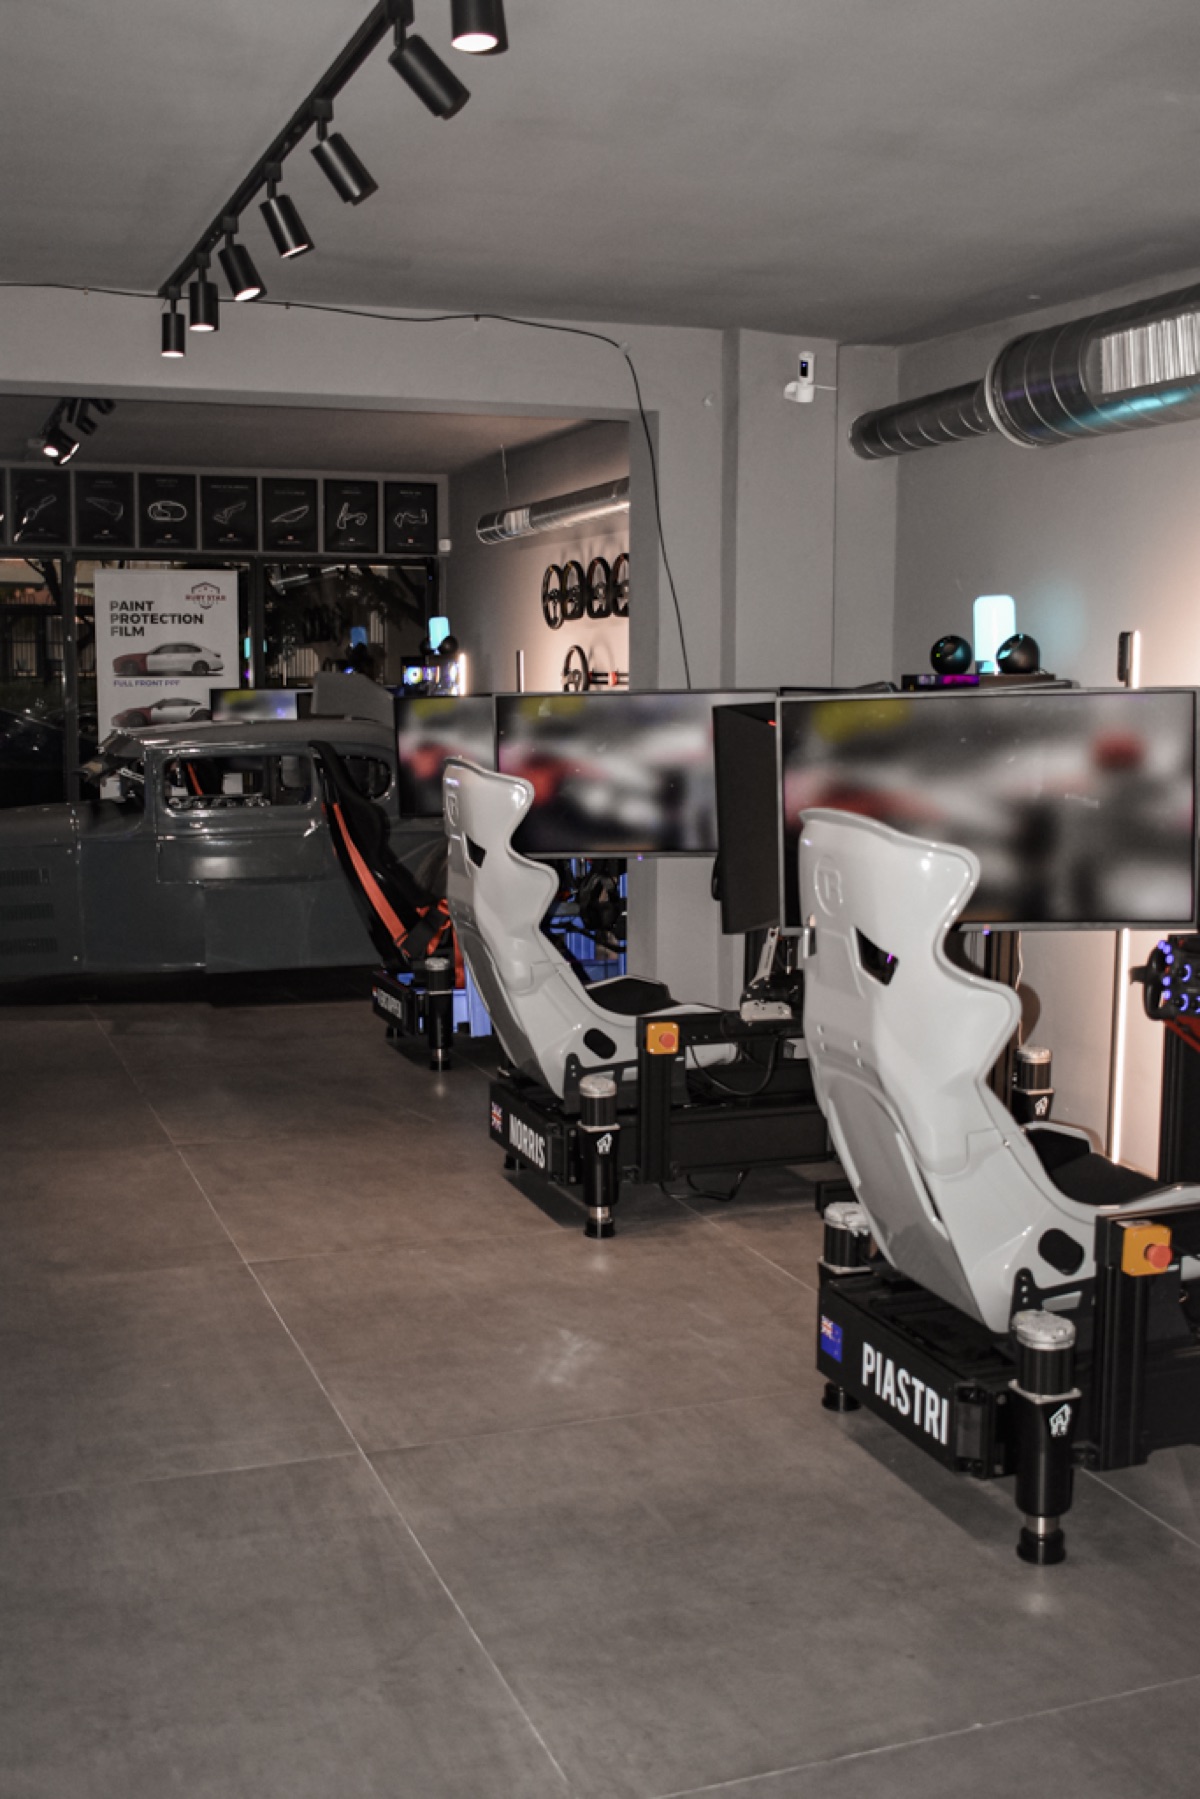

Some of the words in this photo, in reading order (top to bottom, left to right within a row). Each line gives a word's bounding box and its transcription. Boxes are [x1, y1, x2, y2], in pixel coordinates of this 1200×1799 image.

[109, 600, 154, 612] PAINT
[110, 612, 204, 625] PROTECTION
[110, 626, 145, 637] FILM
[113, 679, 134, 688] FULL
[134, 679, 163, 688] FRONT
[509, 1113, 546, 1169] NORRIS
[861, 1341, 949, 1446] PIASTRI
